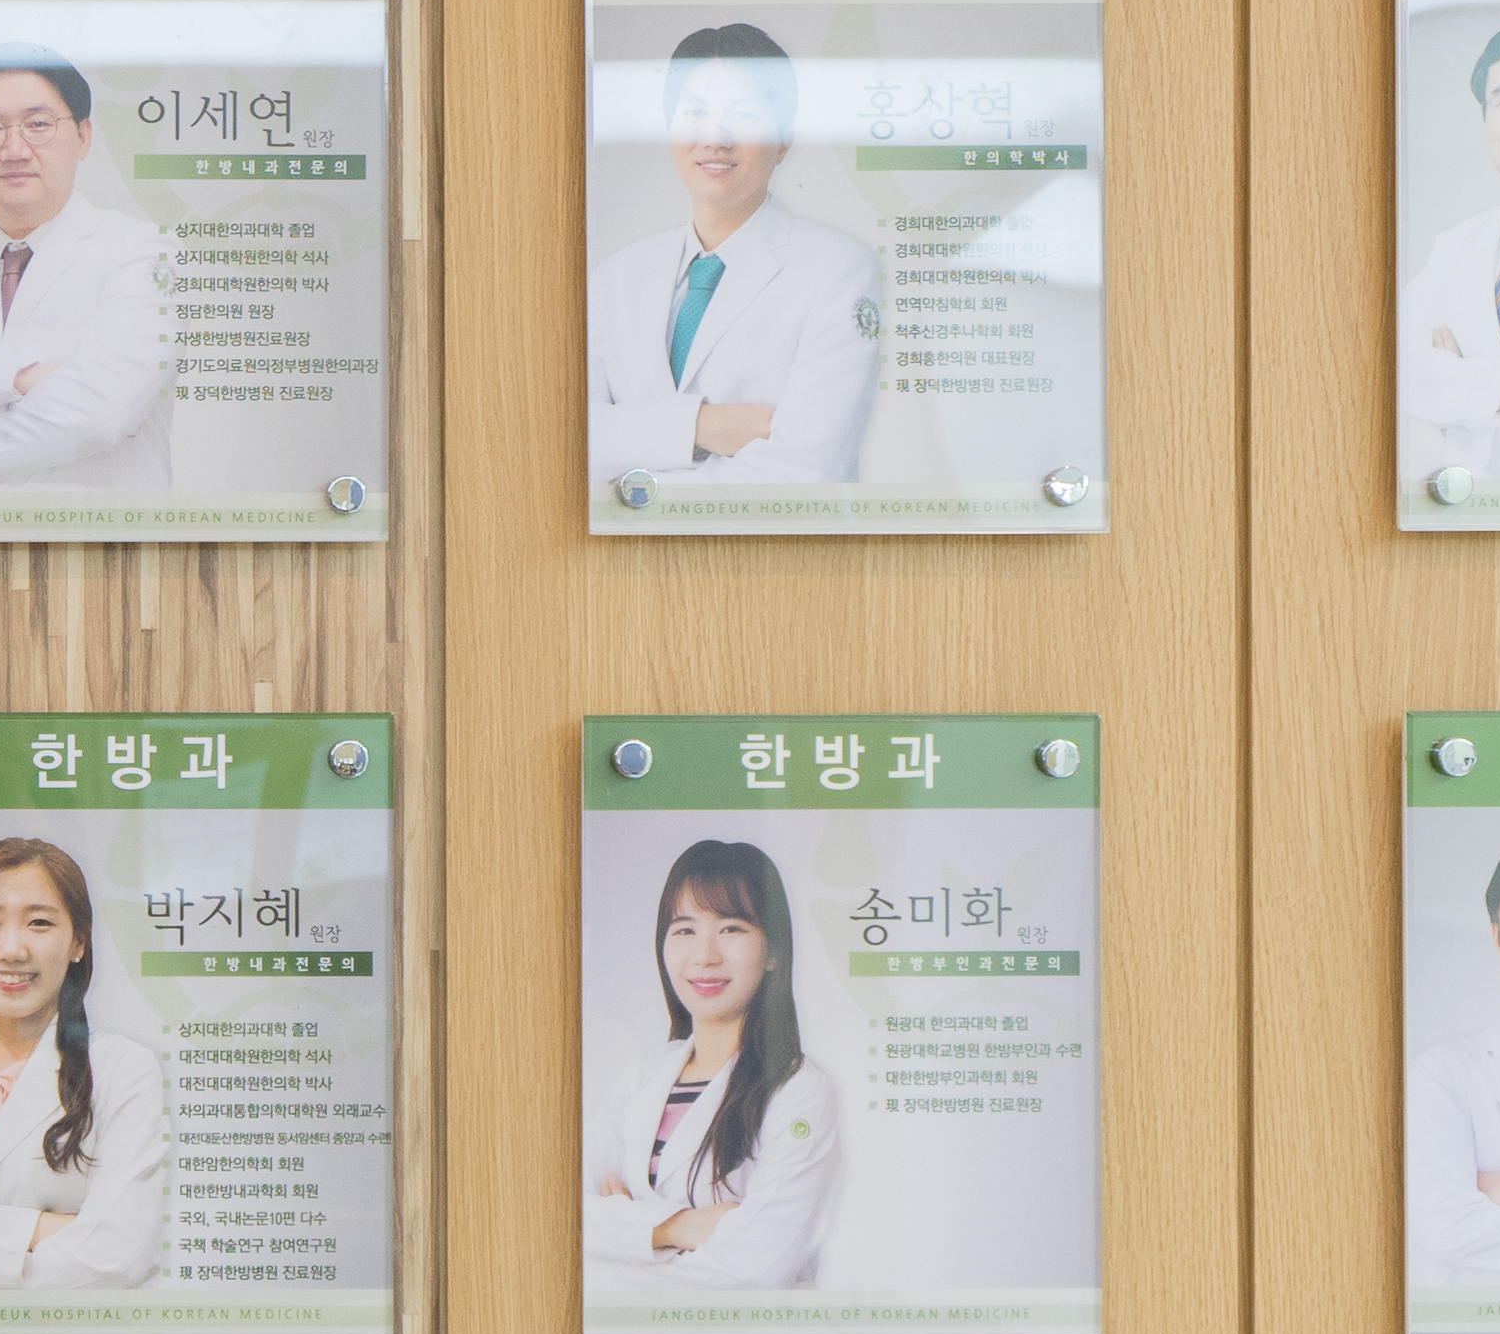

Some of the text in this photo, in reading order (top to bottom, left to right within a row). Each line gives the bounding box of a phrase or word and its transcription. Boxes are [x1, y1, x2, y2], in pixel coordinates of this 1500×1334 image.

[137, 89, 336, 149] 이세연 원장
[857, 80, 1056, 141] 홍상혁 원장
[195, 160, 347, 175] 한방내과전문의
[963, 151, 1069, 166] 한의학박사
[174, 222, 315, 239] 상지대한의과대학 졸업
[30, 733, 233, 790] 한방과
[738, 733, 941, 791] 한방과
[145, 887, 342, 946] 박지혜 원장
[848, 886, 1049, 946] 송미화 원장
[203, 957, 355, 972] 한방내과전문의
[887, 956, 1061, 972] 한방부인과전문의
[884, 1015, 1029, 1033] 원광대 한의과대학 졸업
[179, 1183, 319, 1200] 대한한방내과학회 회원
